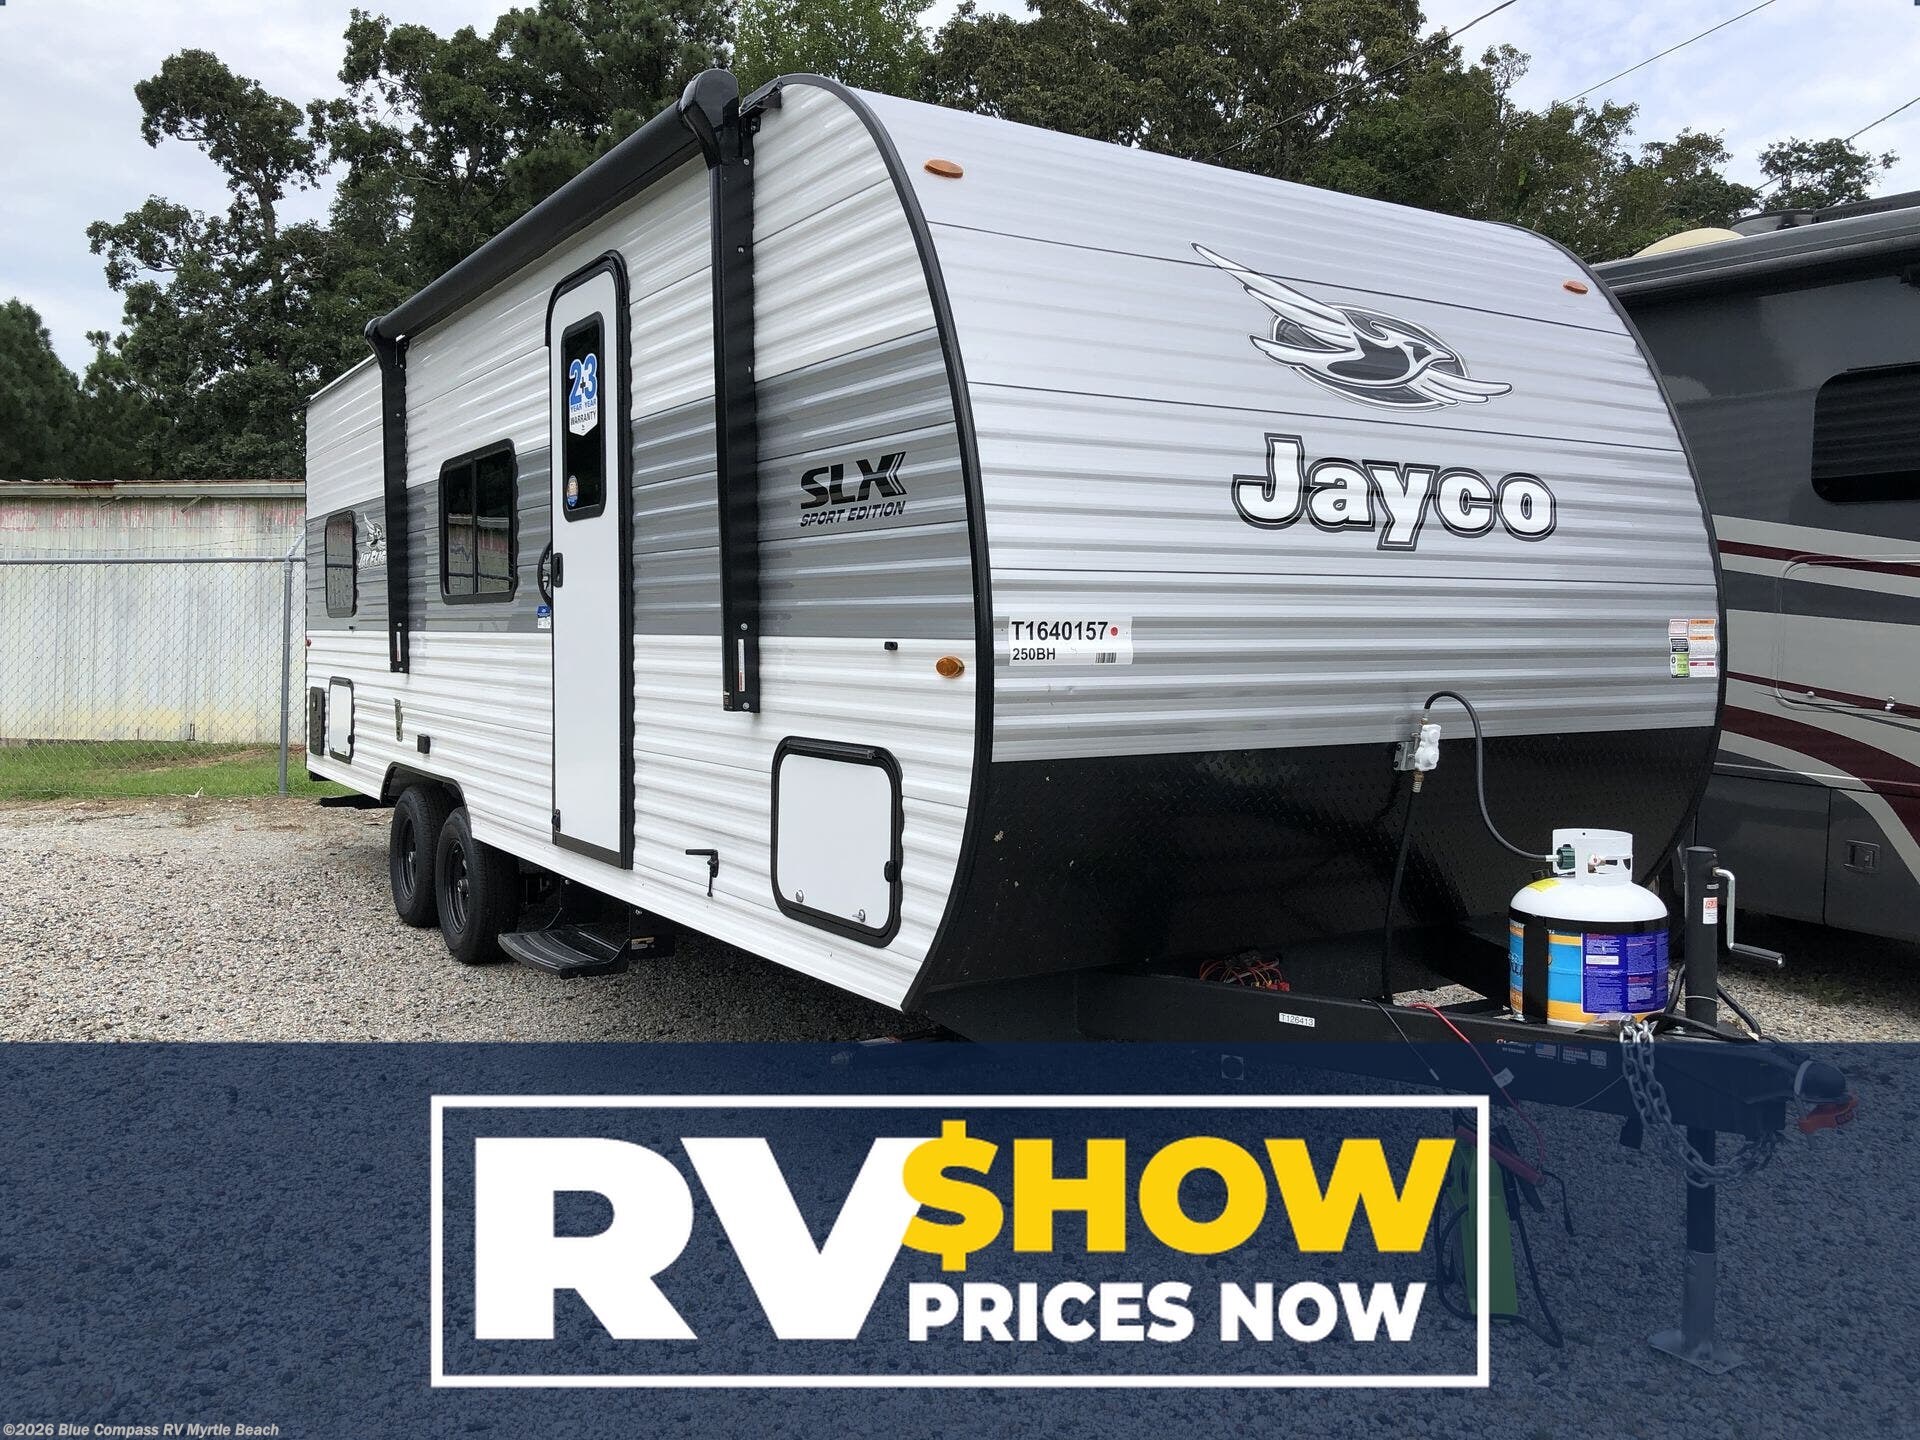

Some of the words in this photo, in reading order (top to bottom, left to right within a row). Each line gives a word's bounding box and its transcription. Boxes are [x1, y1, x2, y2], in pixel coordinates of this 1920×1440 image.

[570, 410, 597, 426] WARRANTY
[800, 451, 907, 510] SLX
[1231, 432, 1556, 551] Jayco
[800, 508, 845, 527] SPORT
[847, 500, 906, 521] EDITION
[1011, 620, 1108, 641] T1640157
[1012, 647, 1056, 661] 250BH
